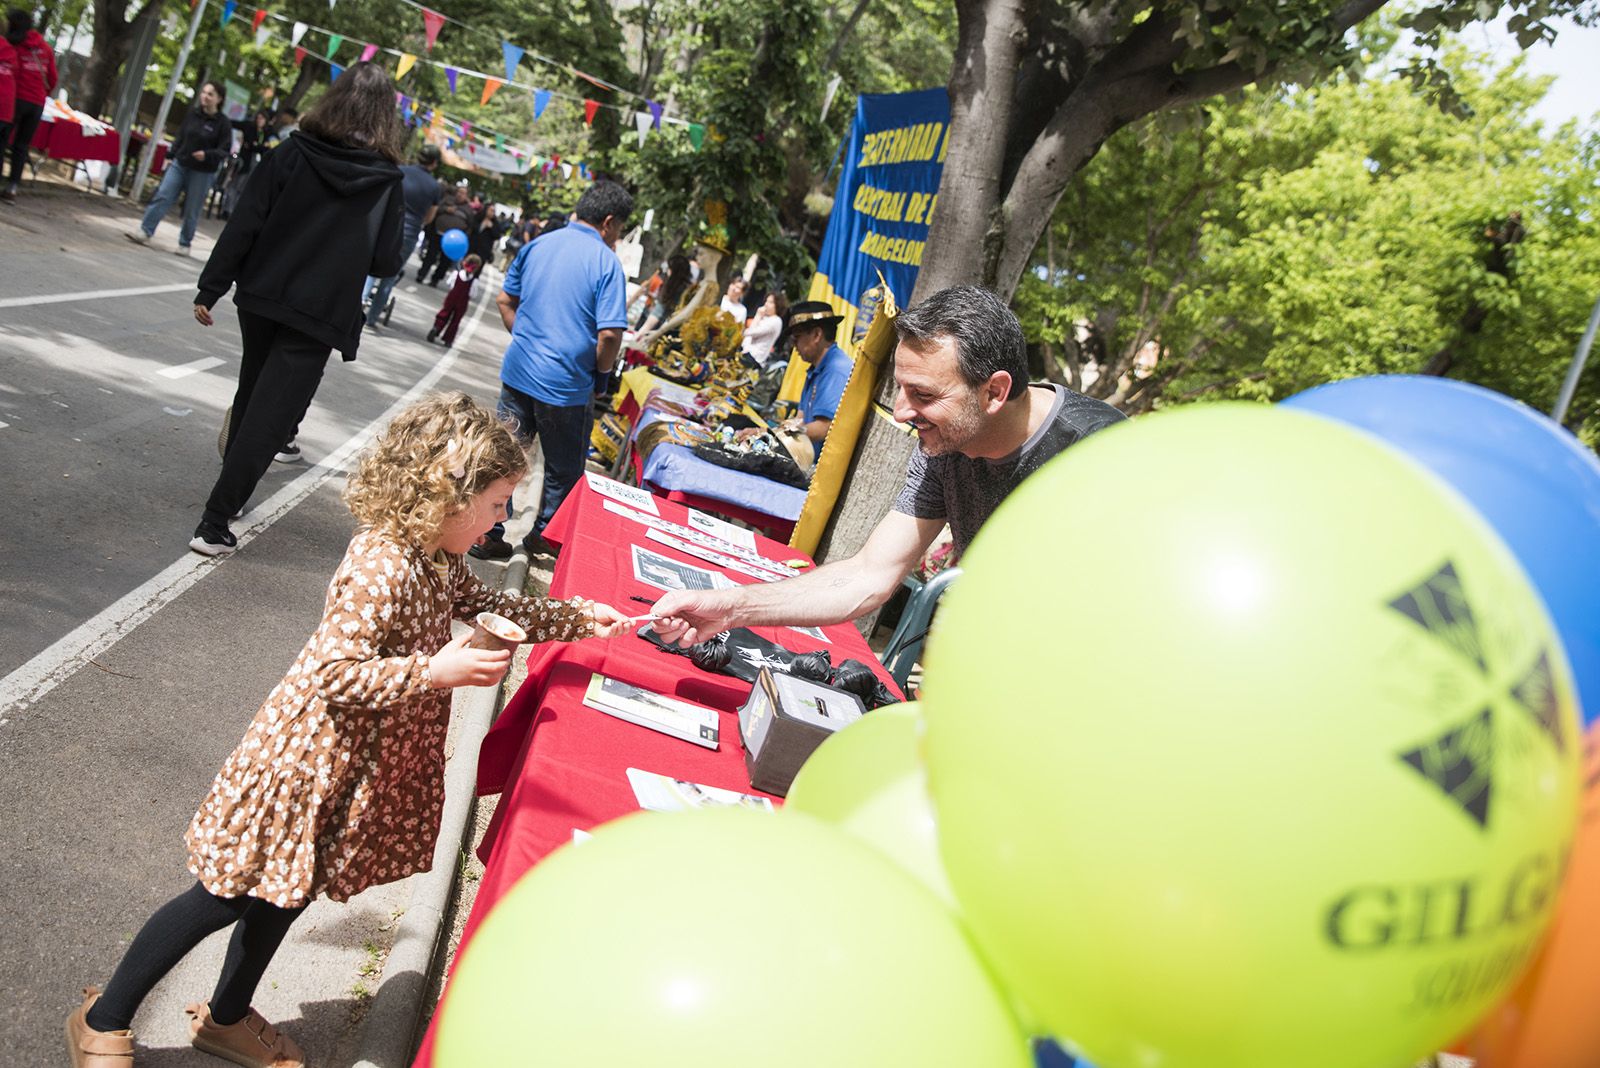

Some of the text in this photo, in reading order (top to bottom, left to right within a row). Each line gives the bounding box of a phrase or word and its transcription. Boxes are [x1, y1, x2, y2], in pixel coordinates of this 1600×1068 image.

[853, 183, 907, 222] CENTRAL
[904, 192, 932, 225] DE
[858, 230, 926, 267] BARCELON
[1320, 848, 1570, 956] GILG
